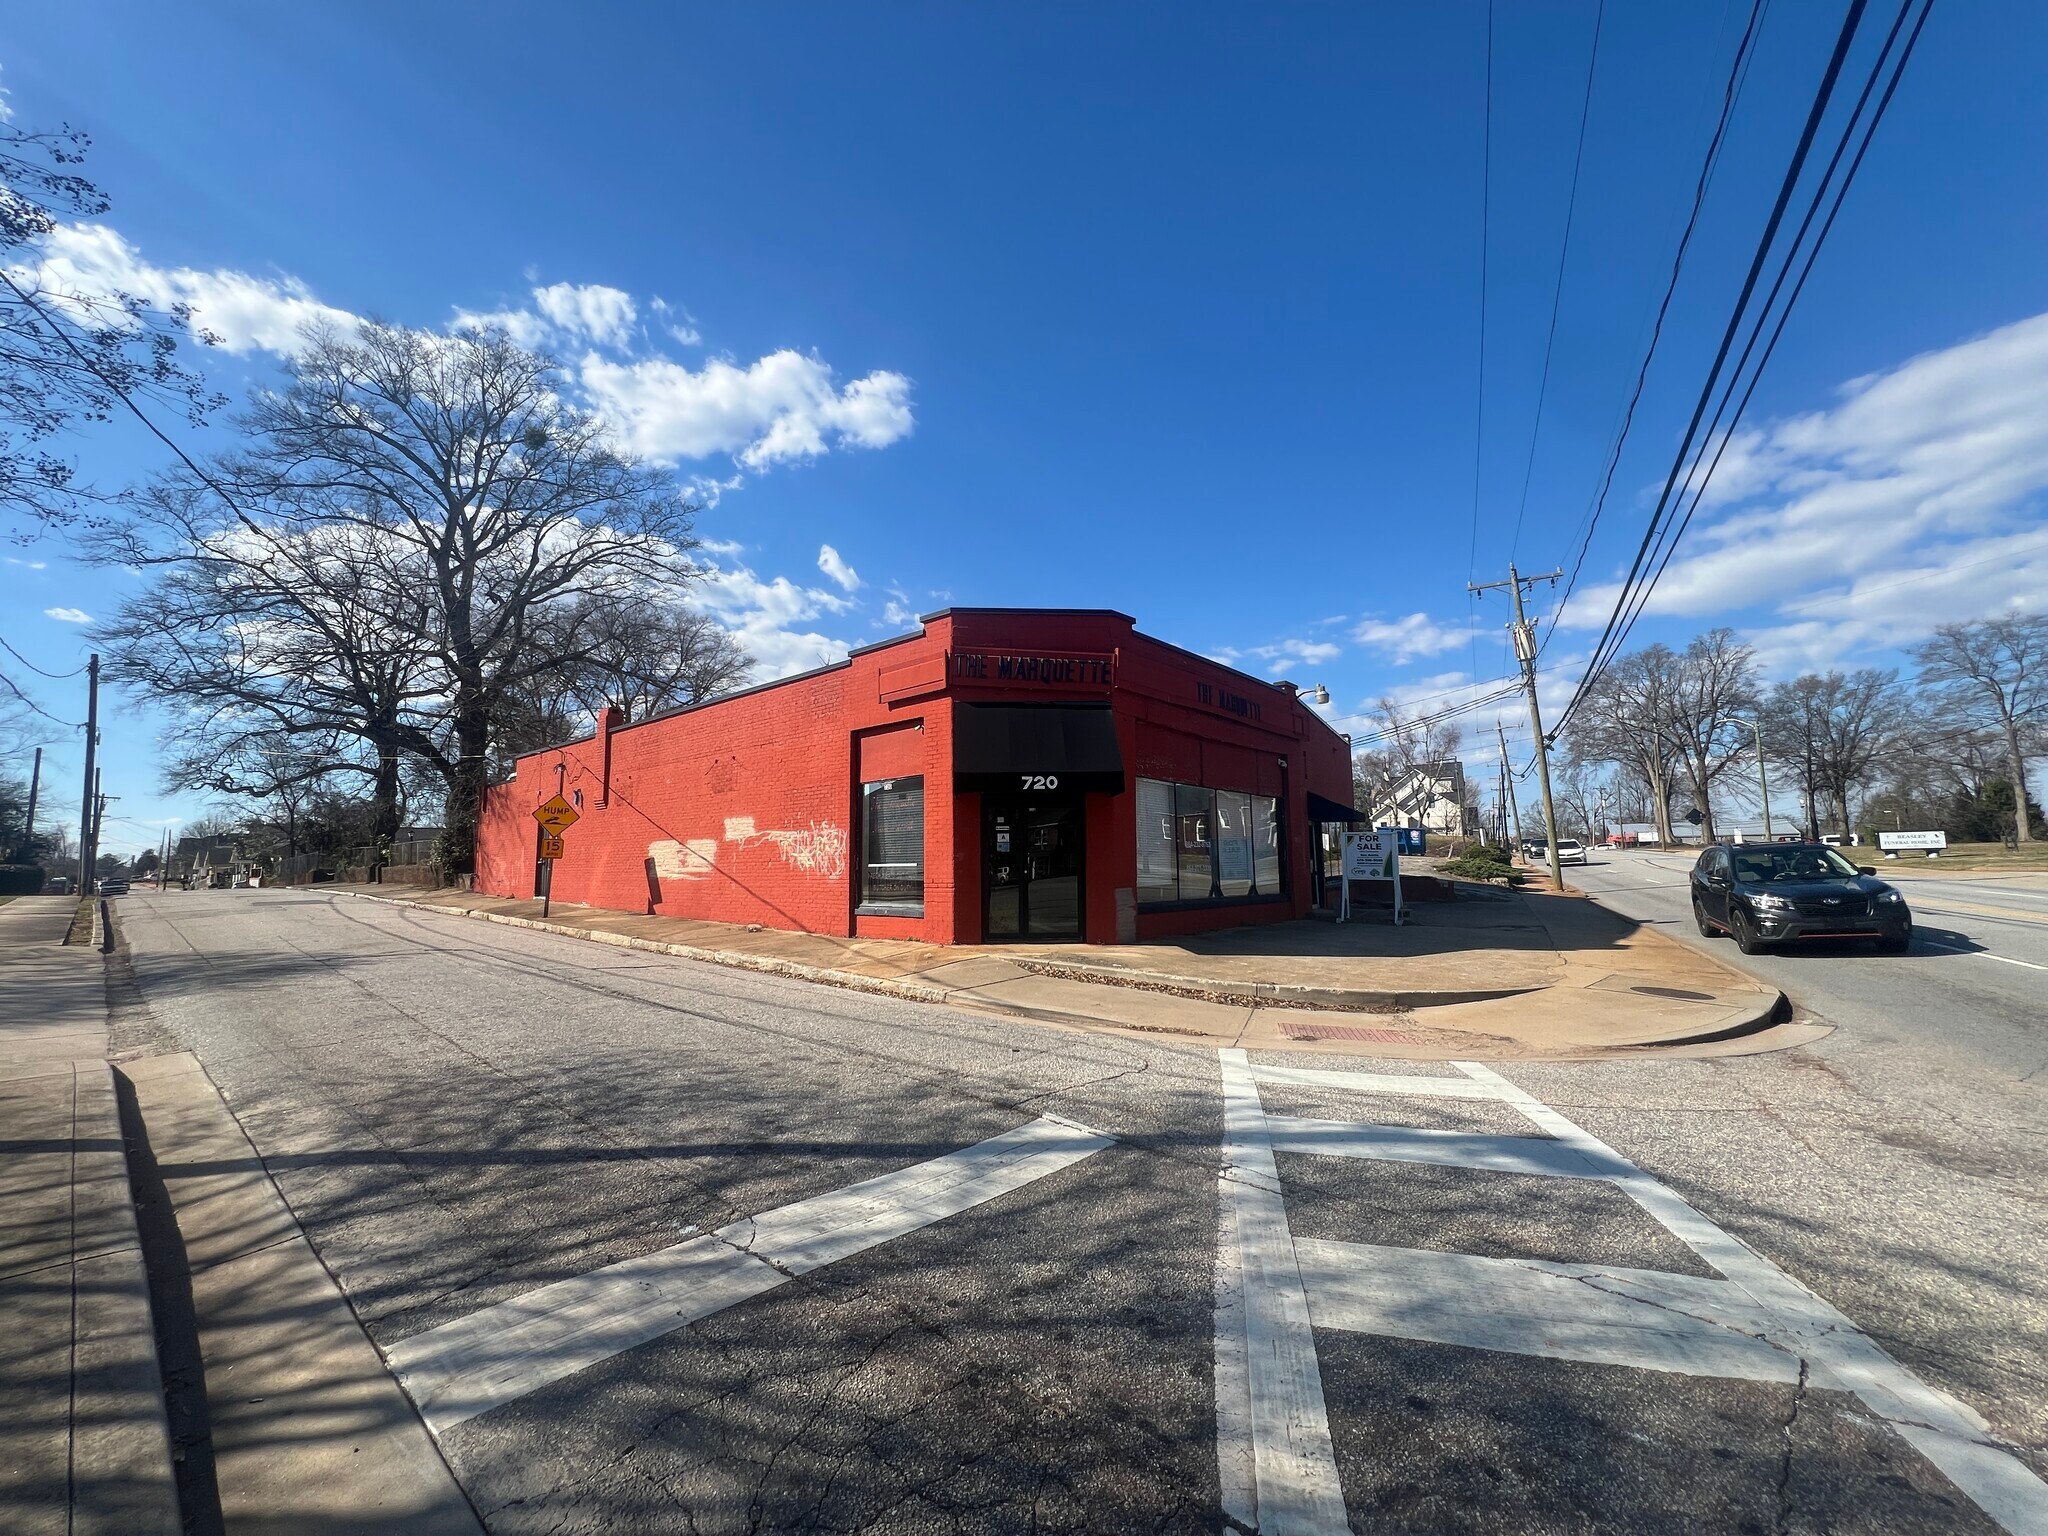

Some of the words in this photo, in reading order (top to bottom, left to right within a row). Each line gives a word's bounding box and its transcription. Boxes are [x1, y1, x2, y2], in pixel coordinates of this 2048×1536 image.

[954, 653, 988, 678] THE
[998, 655, 1113, 684] MARQUETTE
[1021, 775, 1058, 790] 720
[543, 806, 570, 815] HUMP
[546, 841, 560, 851] 15
